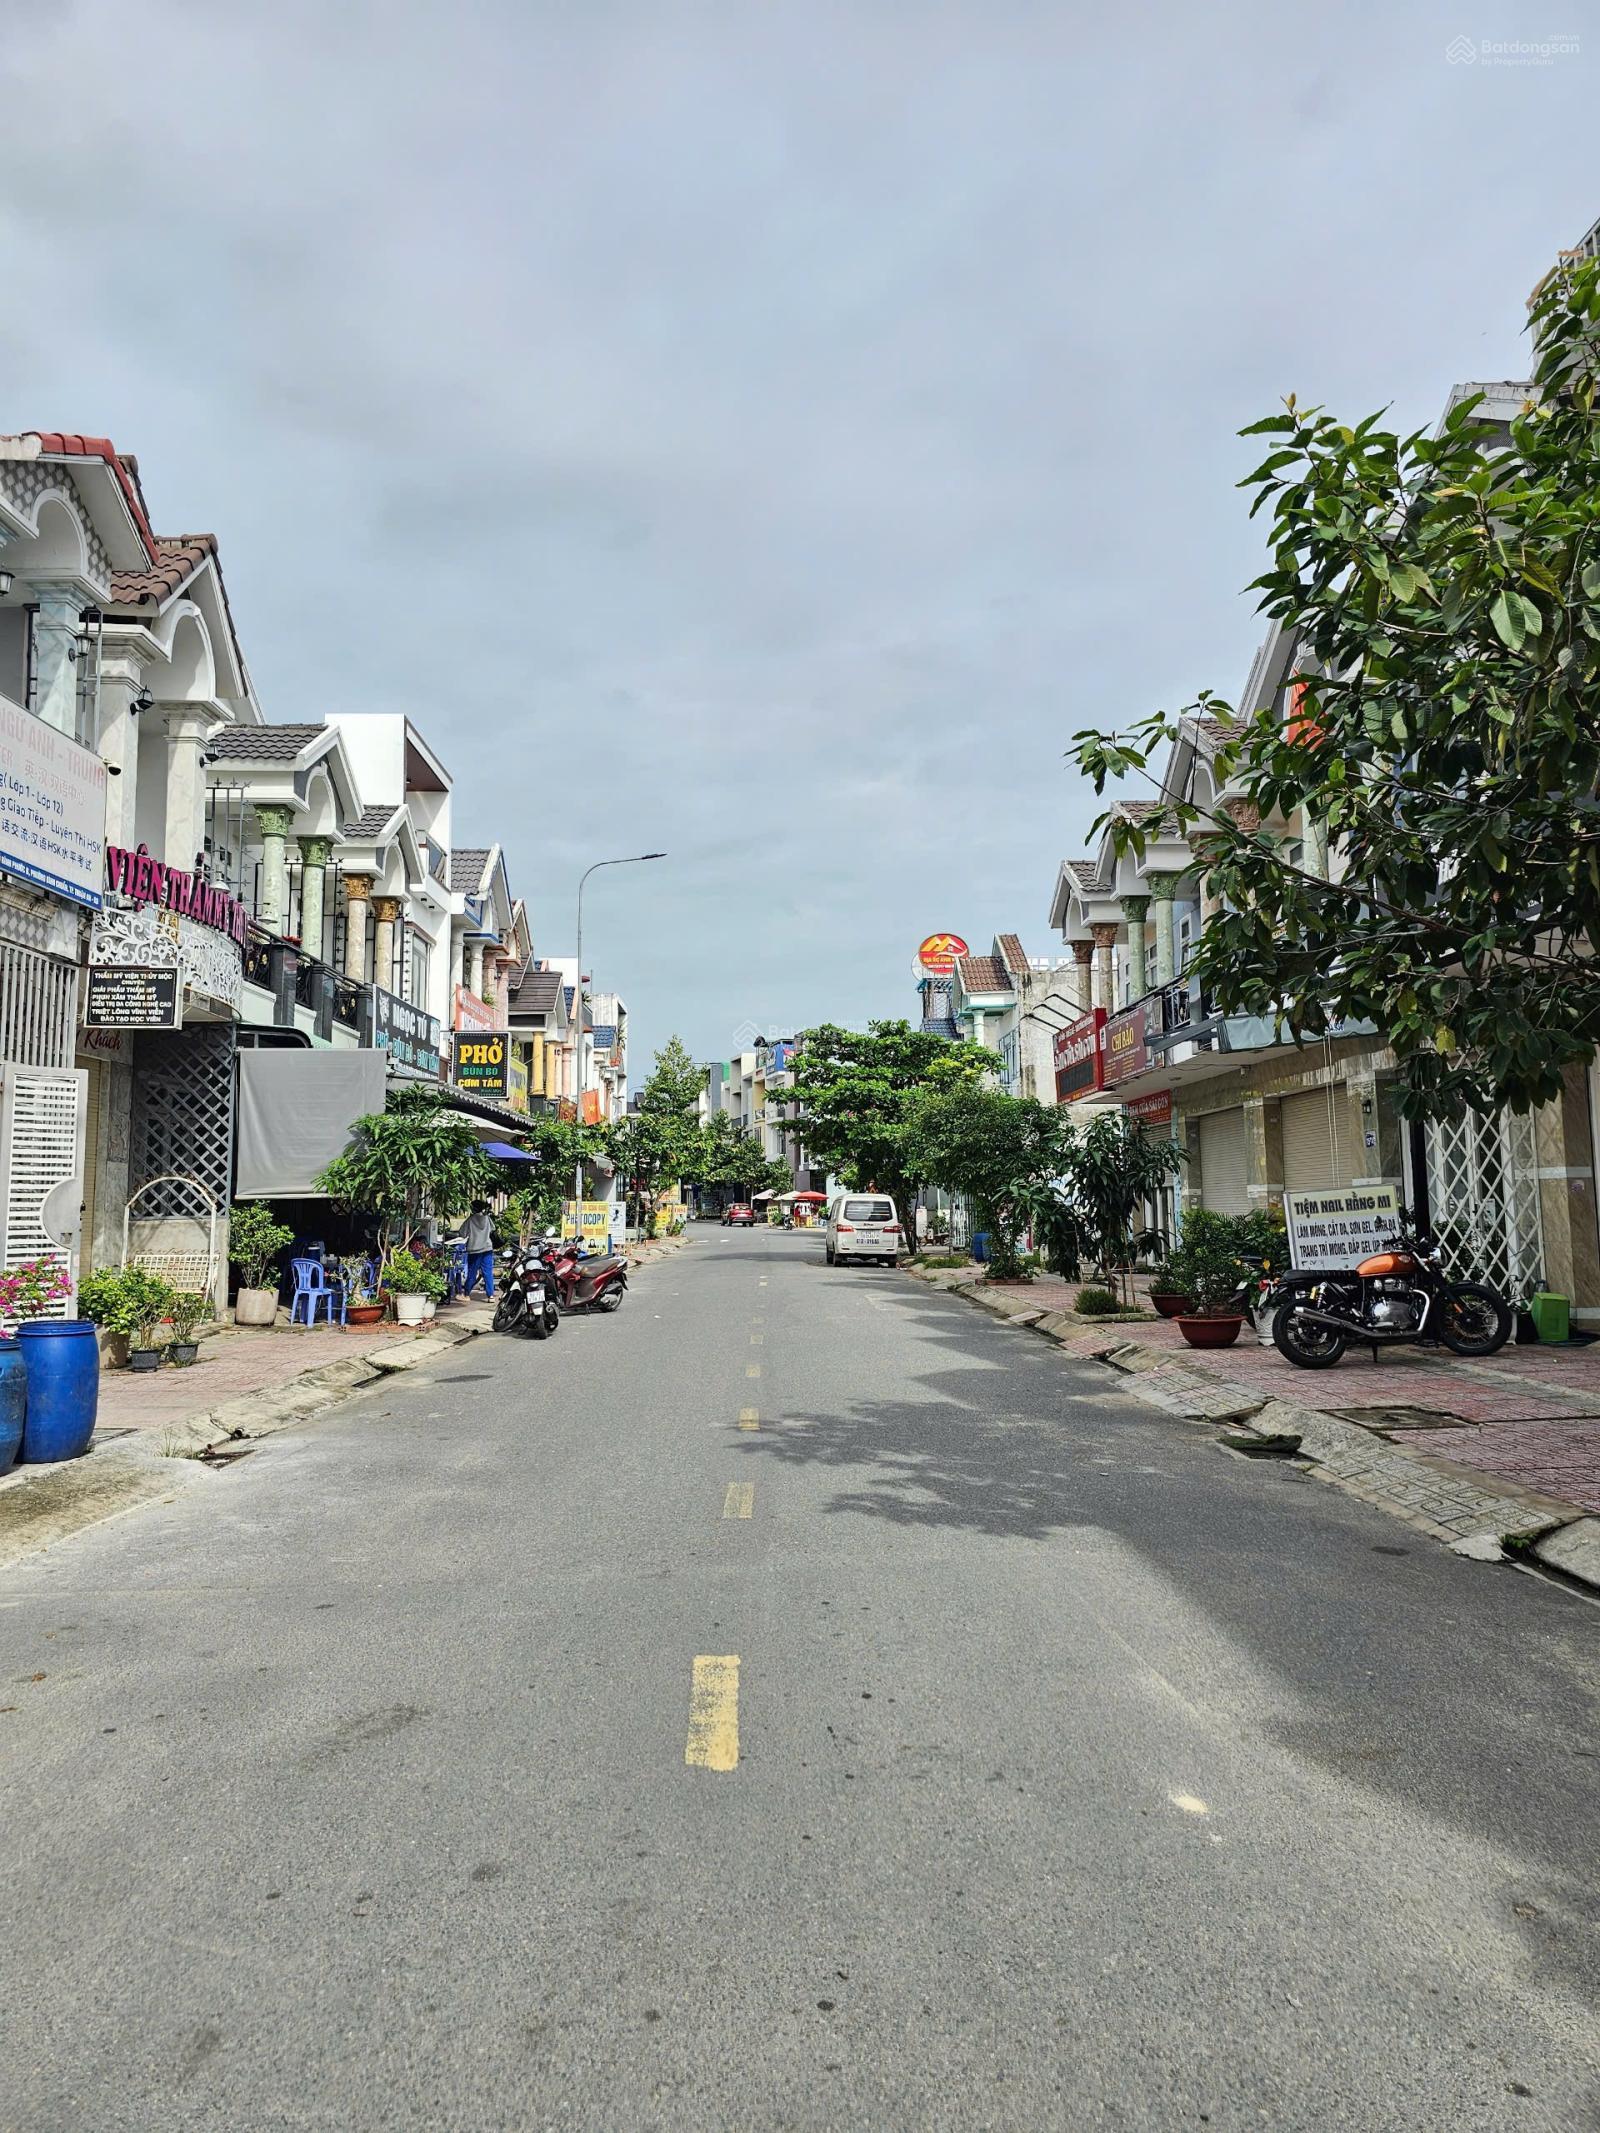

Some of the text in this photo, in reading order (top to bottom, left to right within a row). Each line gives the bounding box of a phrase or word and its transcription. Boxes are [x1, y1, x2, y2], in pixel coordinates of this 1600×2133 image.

[9, 775, 24, 797] Lớp
[37, 791, 51, 811] Lớp
[8, 797, 26, 818] Giao
[28, 807, 44, 829] Tiếp
[74, 831, 86, 847] Thi
[87, 839, 102, 856] HSK
[107, 843, 166, 912] VIỆN
[392, 1003, 416, 1038] NGỌC
[416, 1014, 428, 1040] TÚ
[84, 1028, 121, 1050] Khách
[459, 1037, 503, 1065] PHỞ
[458, 1076, 503, 1088] CƠM TẤM
[1294, 1191, 1391, 1218] TIỆM NAIL HẰNG MI
[1297, 1223, 1309, 1238] LÀM
[1300, 1244, 1319, 1258] TRANG
[1361, 1240, 1372, 1253] GEL
